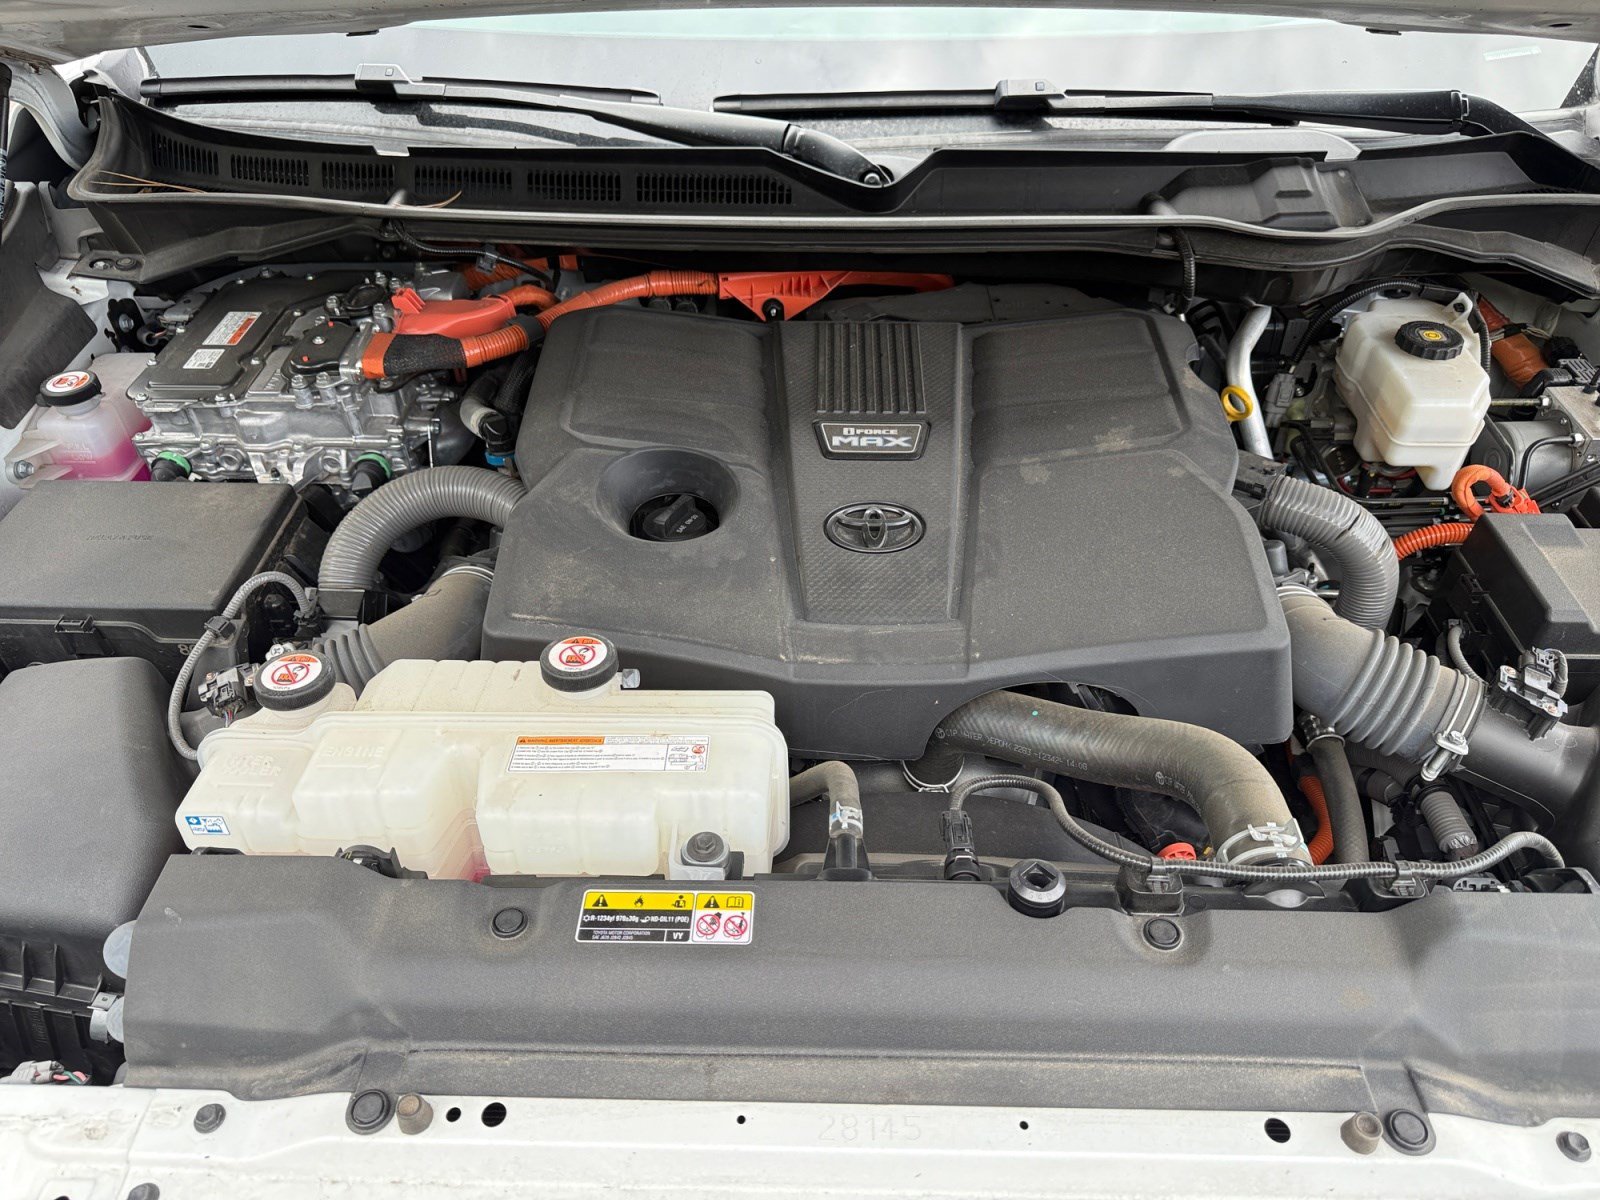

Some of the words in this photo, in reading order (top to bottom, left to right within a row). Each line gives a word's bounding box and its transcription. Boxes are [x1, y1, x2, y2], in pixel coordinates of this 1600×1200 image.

[831, 435, 912, 447] MAX
[675, 524, 687, 534] SAE
[672, 932, 683, 940] VY
[817, 1113, 921, 1142] 28145
